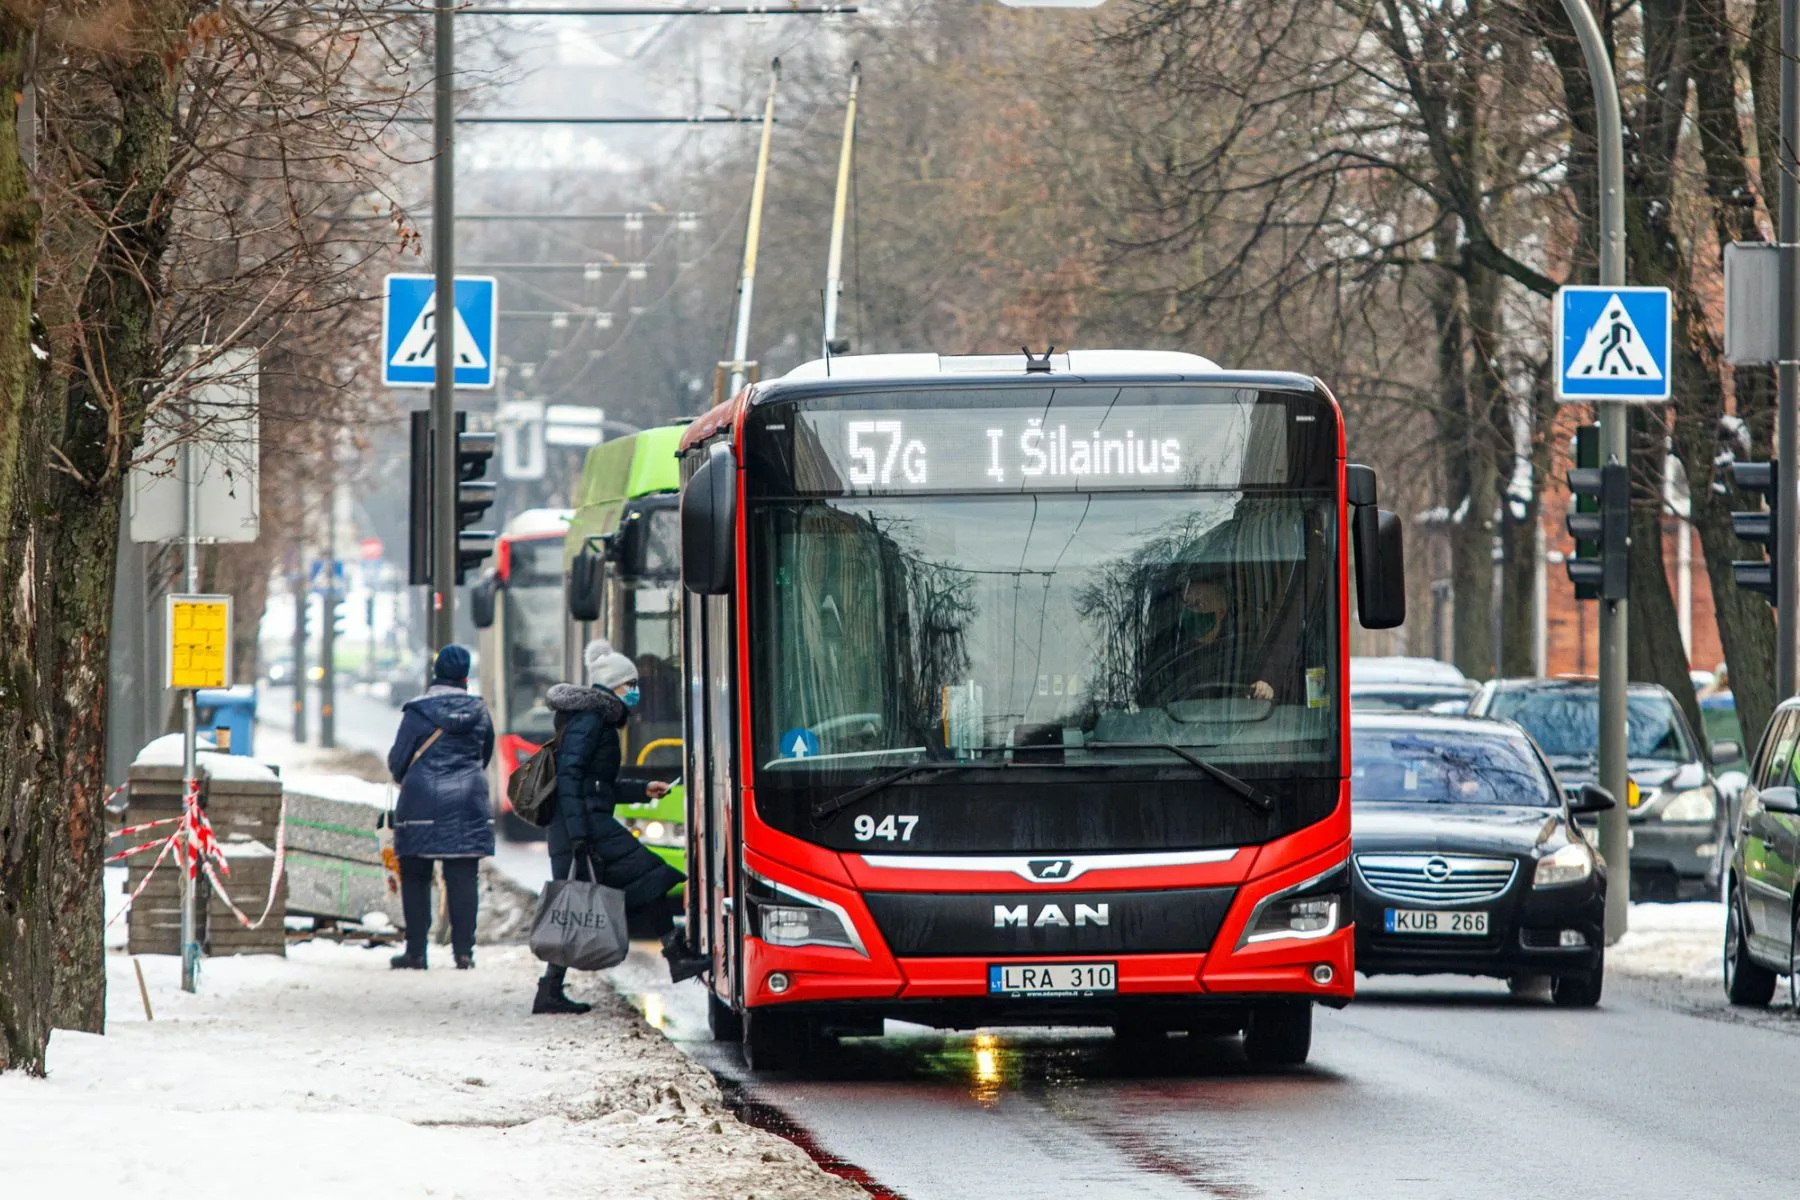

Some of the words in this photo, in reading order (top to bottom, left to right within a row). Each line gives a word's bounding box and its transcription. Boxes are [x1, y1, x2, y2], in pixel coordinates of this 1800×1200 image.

[849, 421, 926, 484] 57G
[1020, 418, 1180, 475] Šilainius
[854, 814, 919, 841] 947
[994, 903, 1109, 927] MAN
[1397, 912, 1437, 930] KUB
[1452, 914, 1484, 931] 266
[1005, 968, 1053, 988] LRA
[1071, 968, 1110, 987] 310
